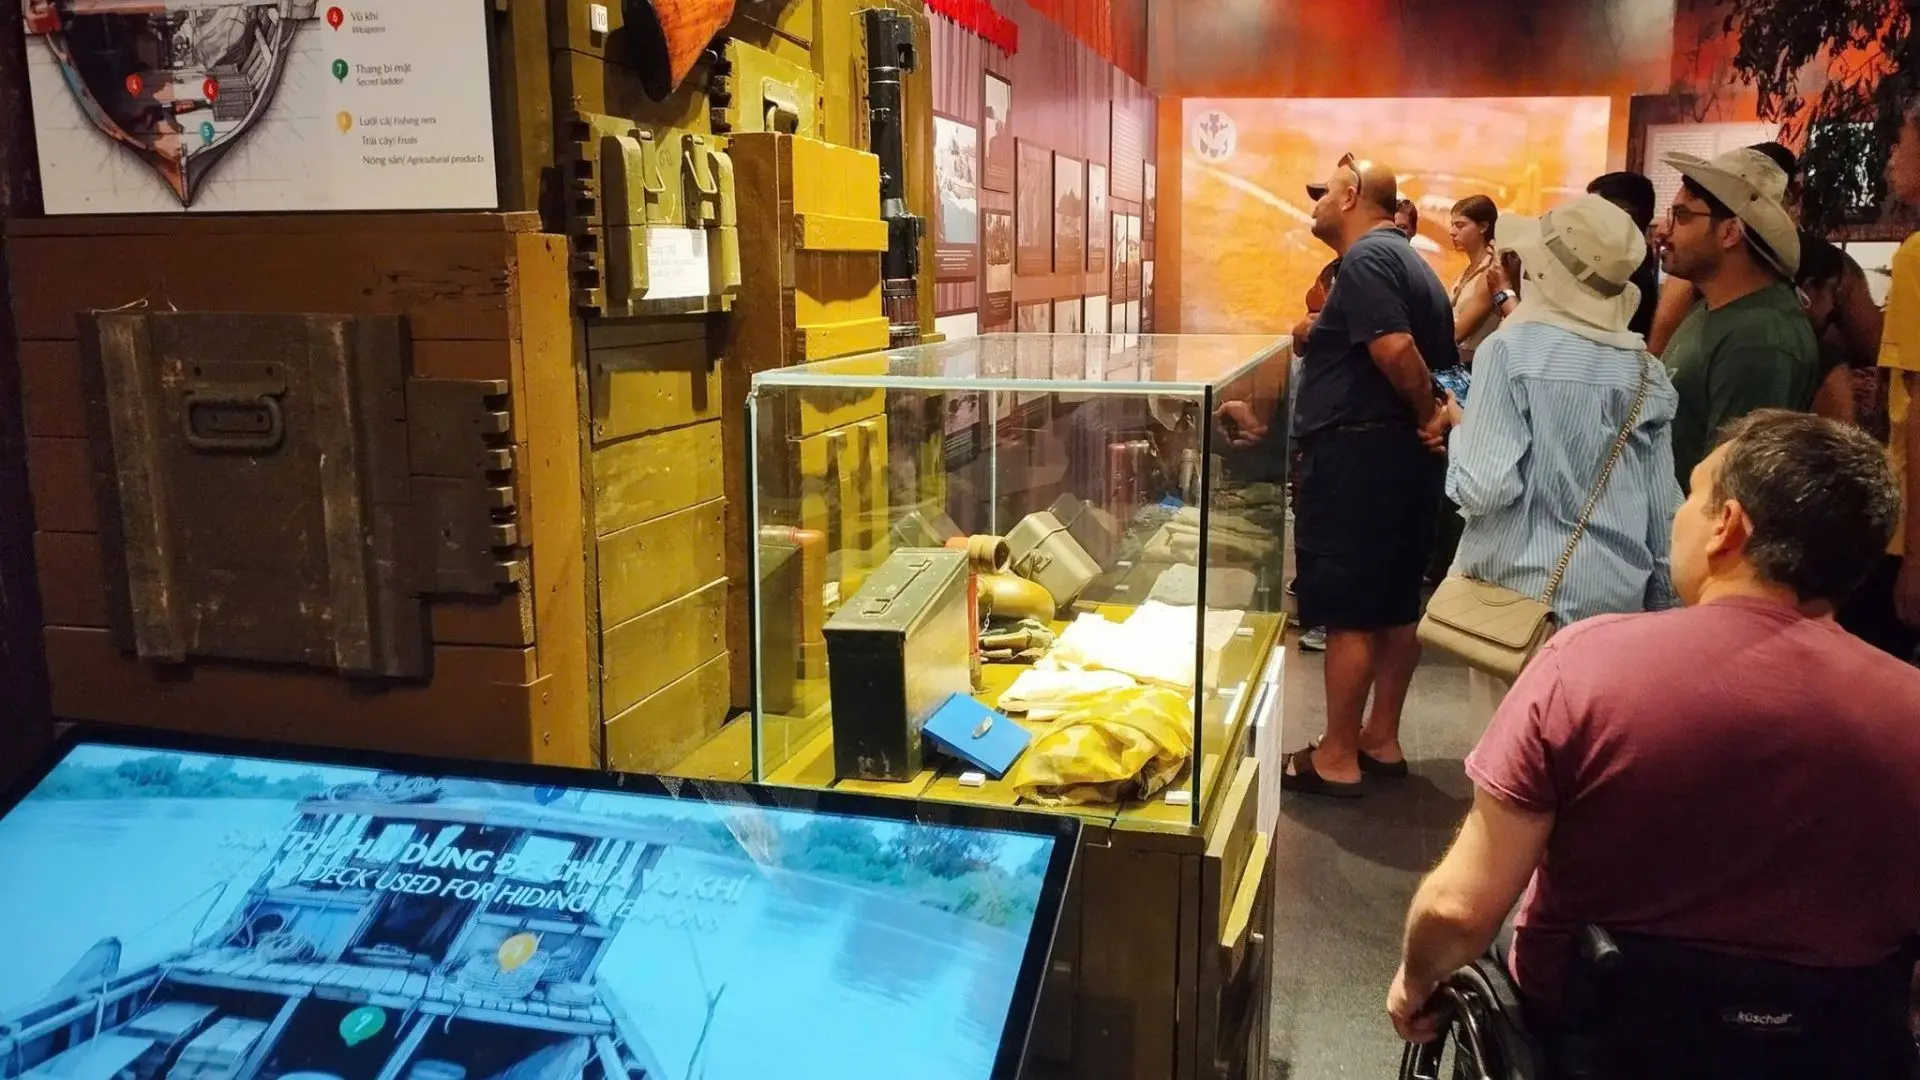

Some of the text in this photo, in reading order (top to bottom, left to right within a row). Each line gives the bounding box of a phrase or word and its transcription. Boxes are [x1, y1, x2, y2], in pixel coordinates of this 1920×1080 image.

[596, 11, 607, 26] 10
[352, 26, 386, 34] Weapons
[356, 64, 382, 75] Thang
[356, 77, 403, 86] Secret ladder
[394, 117, 420, 127] Fishing
[421, 117, 437, 125] nets
[397, 136, 418, 145] Fruits
[407, 155, 449, 166] Agricultural
[451, 154, 485, 165] products
[297, 864, 379, 888] DECK
[374, 869, 442, 895] USED
[438, 877, 496, 902] FOR
[494, 884, 590, 913] HIDING
